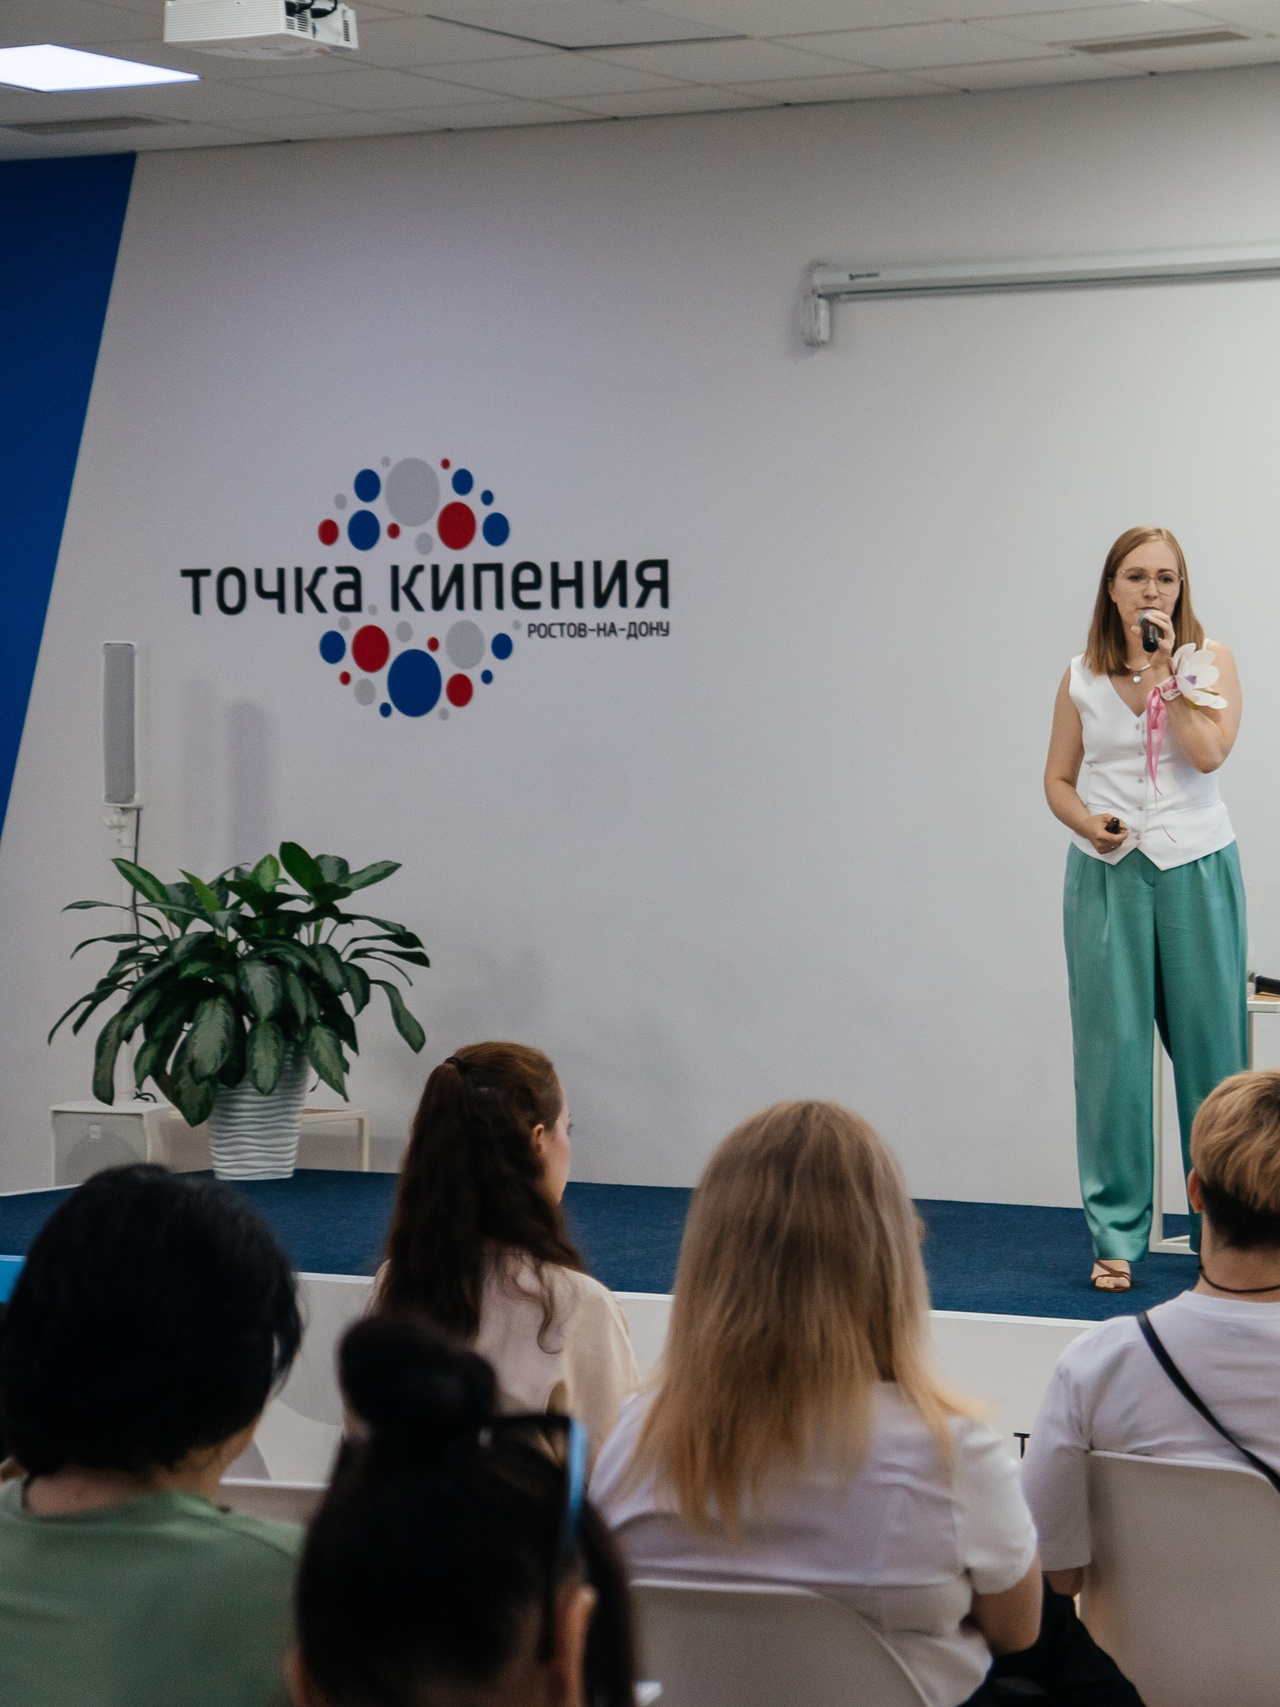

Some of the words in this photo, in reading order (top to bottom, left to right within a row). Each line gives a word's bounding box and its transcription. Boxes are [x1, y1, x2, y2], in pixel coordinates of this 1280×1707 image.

[179, 566, 363, 616] точка
[390, 558, 670, 612] кипения
[527, 621, 670, 641] РОСТОВ-НА-ДОНУ
